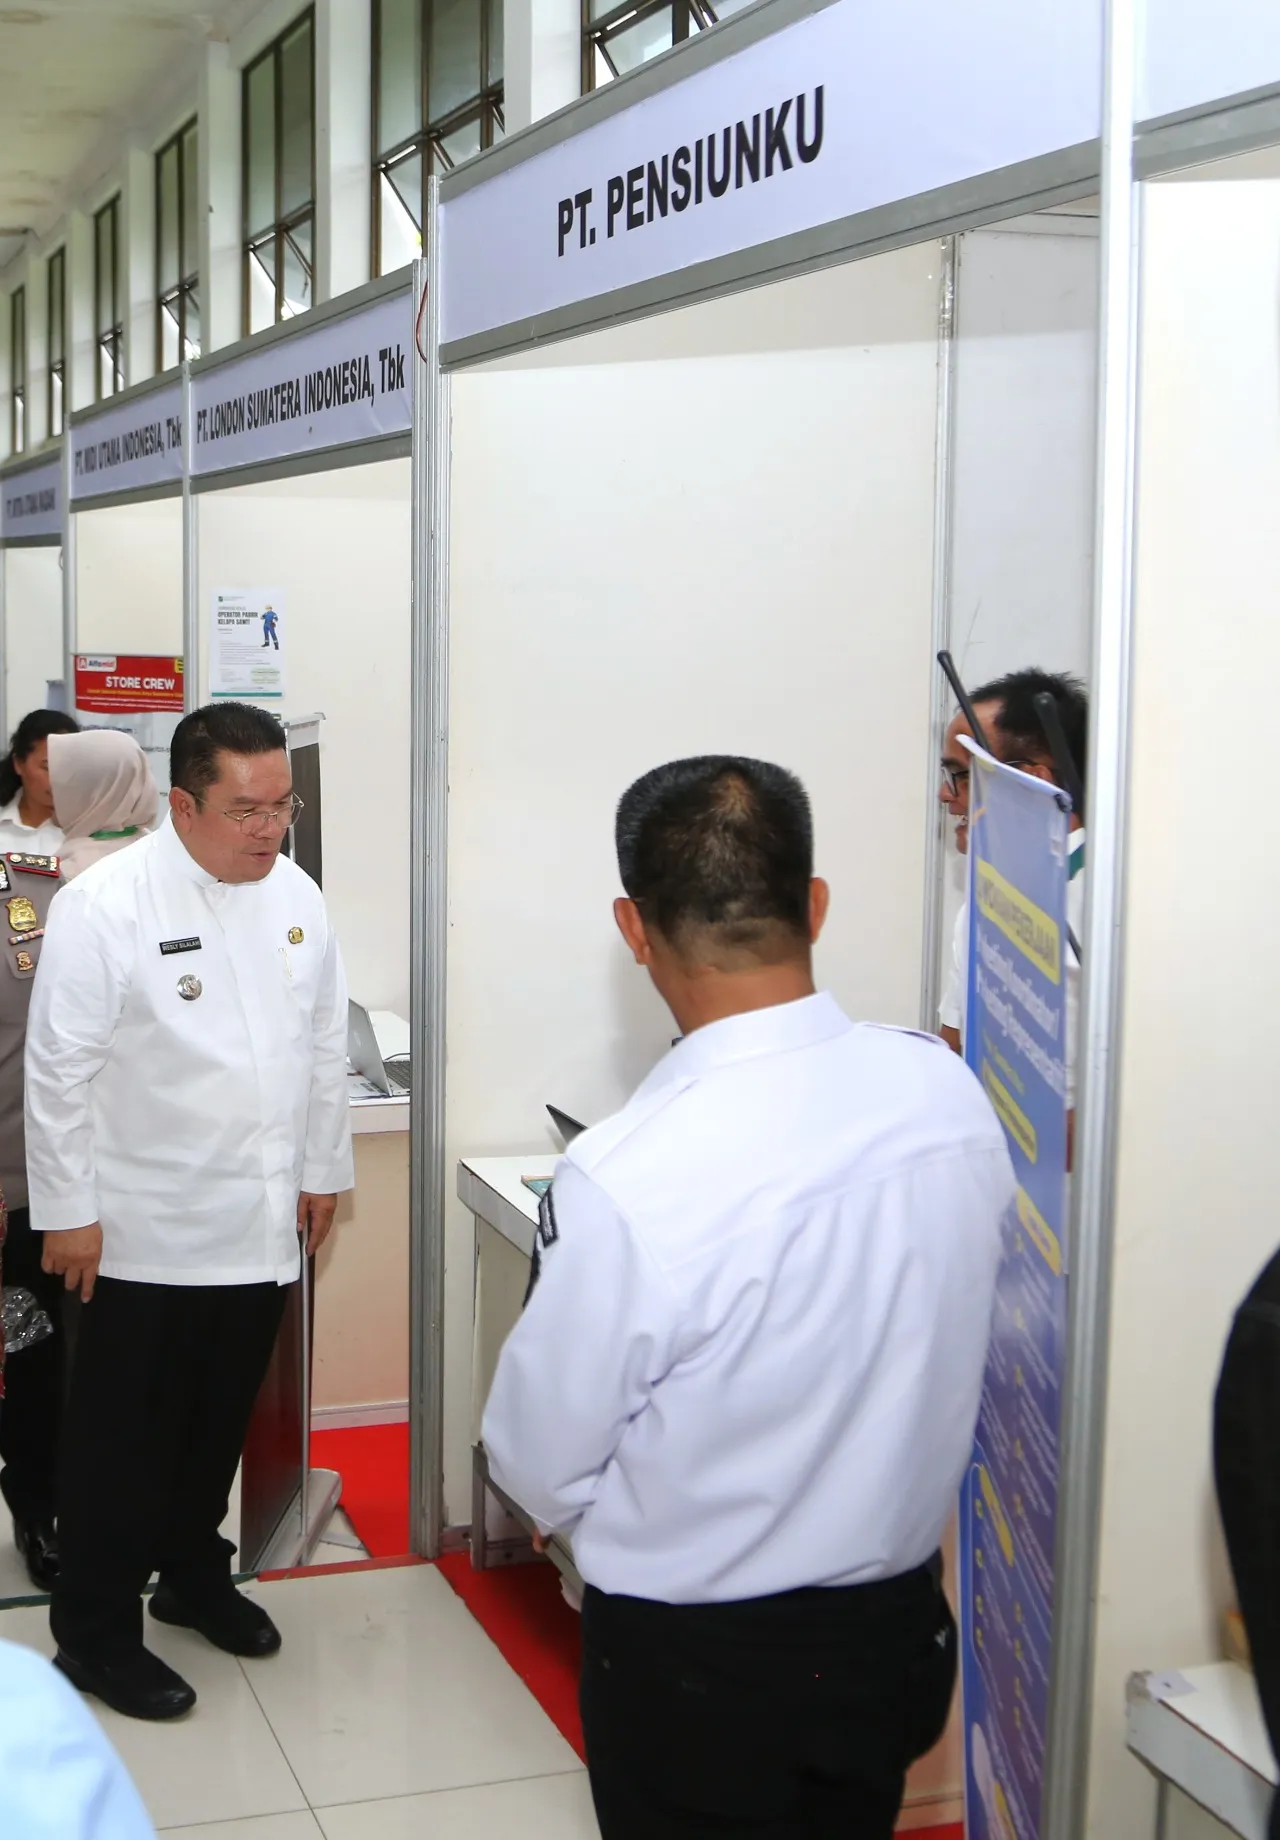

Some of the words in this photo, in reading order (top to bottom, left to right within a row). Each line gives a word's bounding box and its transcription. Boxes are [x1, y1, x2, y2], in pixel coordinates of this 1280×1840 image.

[558, 188, 596, 257] PT.
[607, 85, 824, 238] PENSIUNKU
[197, 414, 208, 444] PT.
[210, 396, 245, 440] LONDON
[247, 378, 302, 431] SUMATERA
[304, 355, 375, 414] INDONESIA,
[379, 344, 406, 394] Tbk
[122, 422, 165, 462] INDONESIA,
[166, 416, 182, 450] Tbk
[106, 676, 141, 689] STORE
[143, 677, 175, 690] CREW
